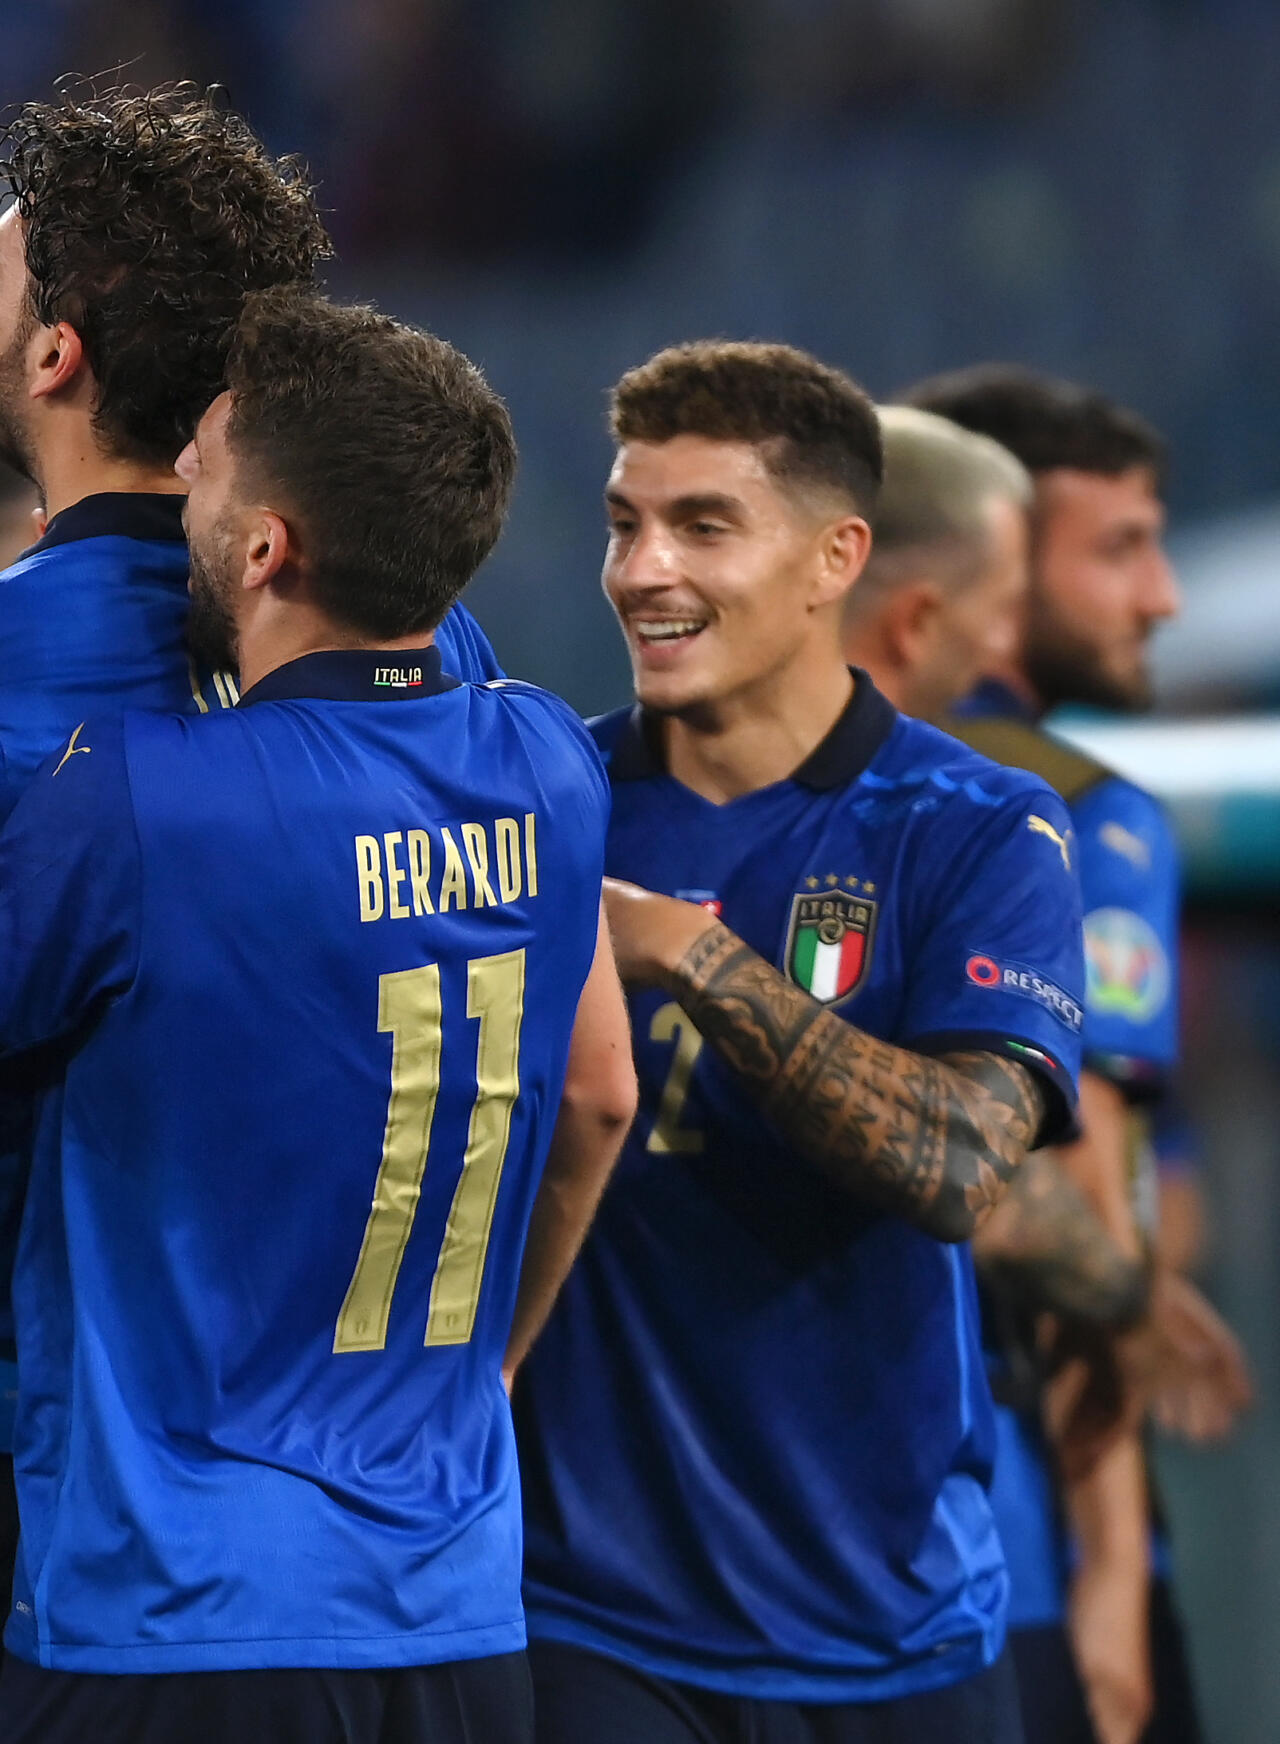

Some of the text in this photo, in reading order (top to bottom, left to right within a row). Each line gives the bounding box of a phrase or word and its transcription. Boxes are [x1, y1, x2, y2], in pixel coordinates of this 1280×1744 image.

[375, 667, 422, 682] ITALIA
[355, 812, 538, 923] BERARDI
[801, 900, 868, 923] ITALIA
[646, 1001, 705, 1153] 2
[332, 947, 526, 1354] 11
